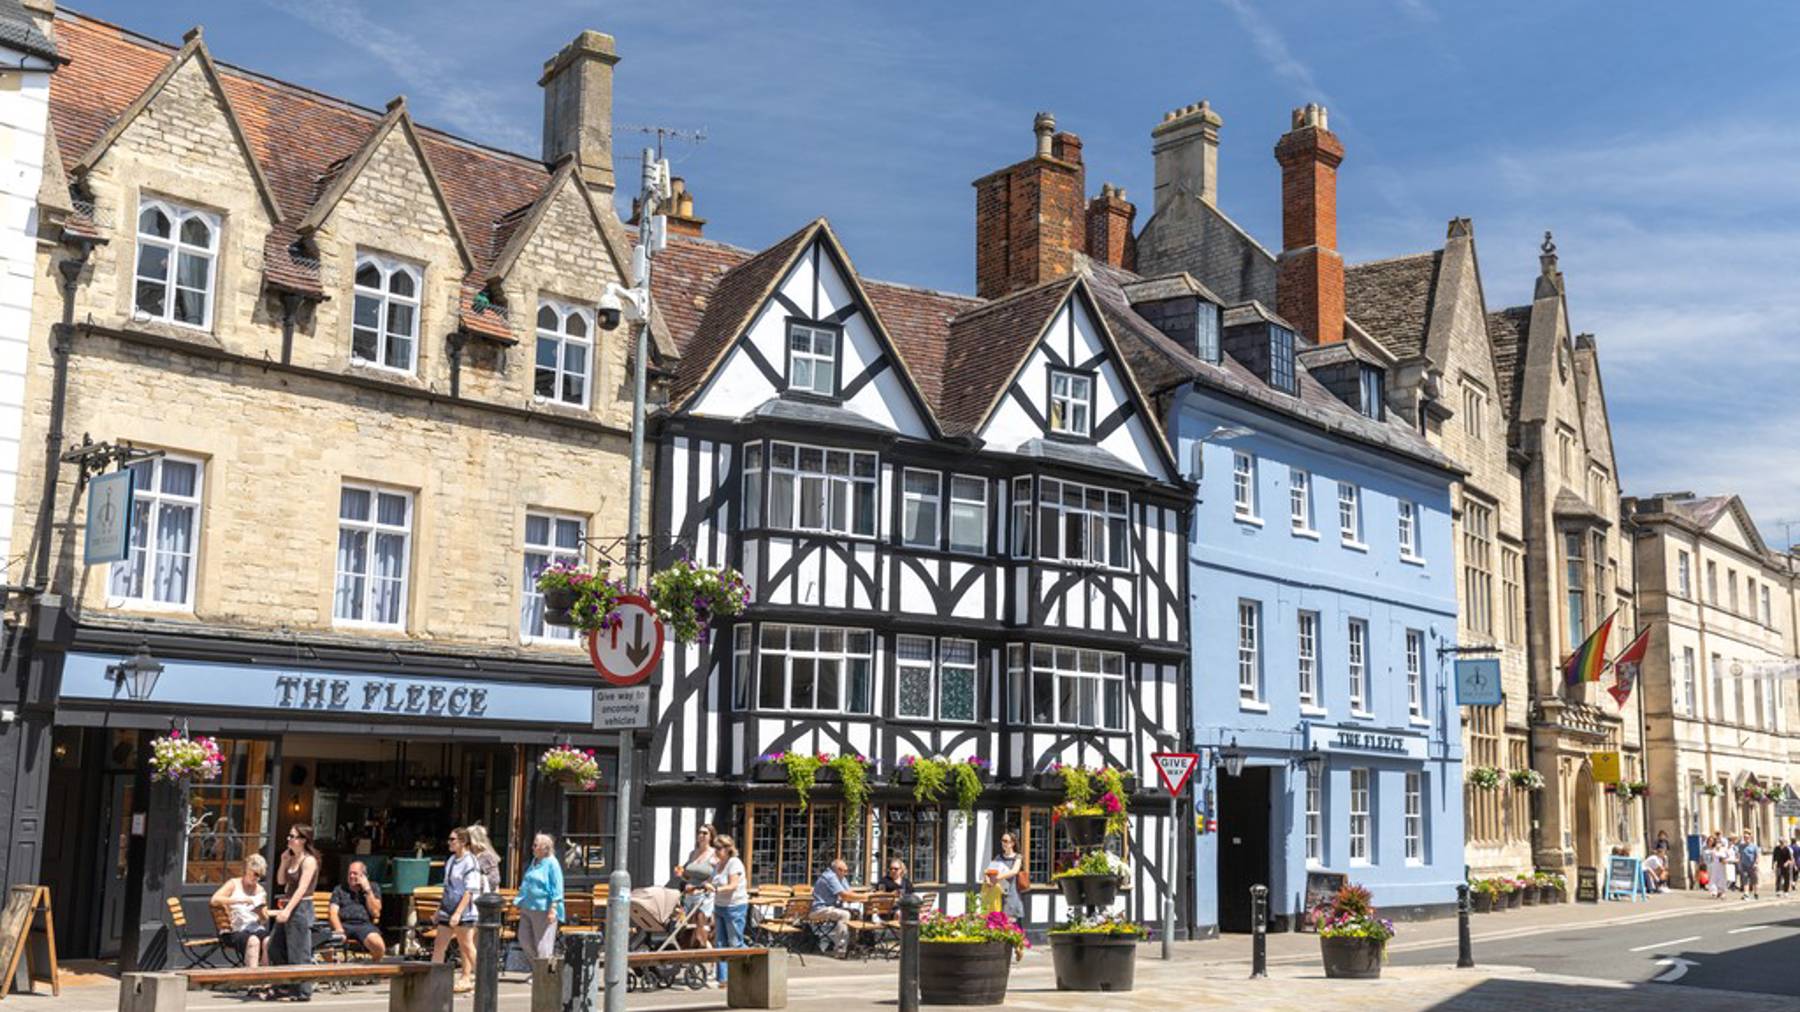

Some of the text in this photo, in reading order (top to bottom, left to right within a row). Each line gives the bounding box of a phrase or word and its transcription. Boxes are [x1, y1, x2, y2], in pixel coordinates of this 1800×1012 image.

[276, 676, 488, 716] THE FLEECE
[597, 690, 646, 701] Give way to
[602, 704, 640, 714] oncoming
[605, 716, 636, 725] vehicles
[1337, 732, 1405, 752] THE FLEECE
[1161, 758, 1188, 768] GIVE
